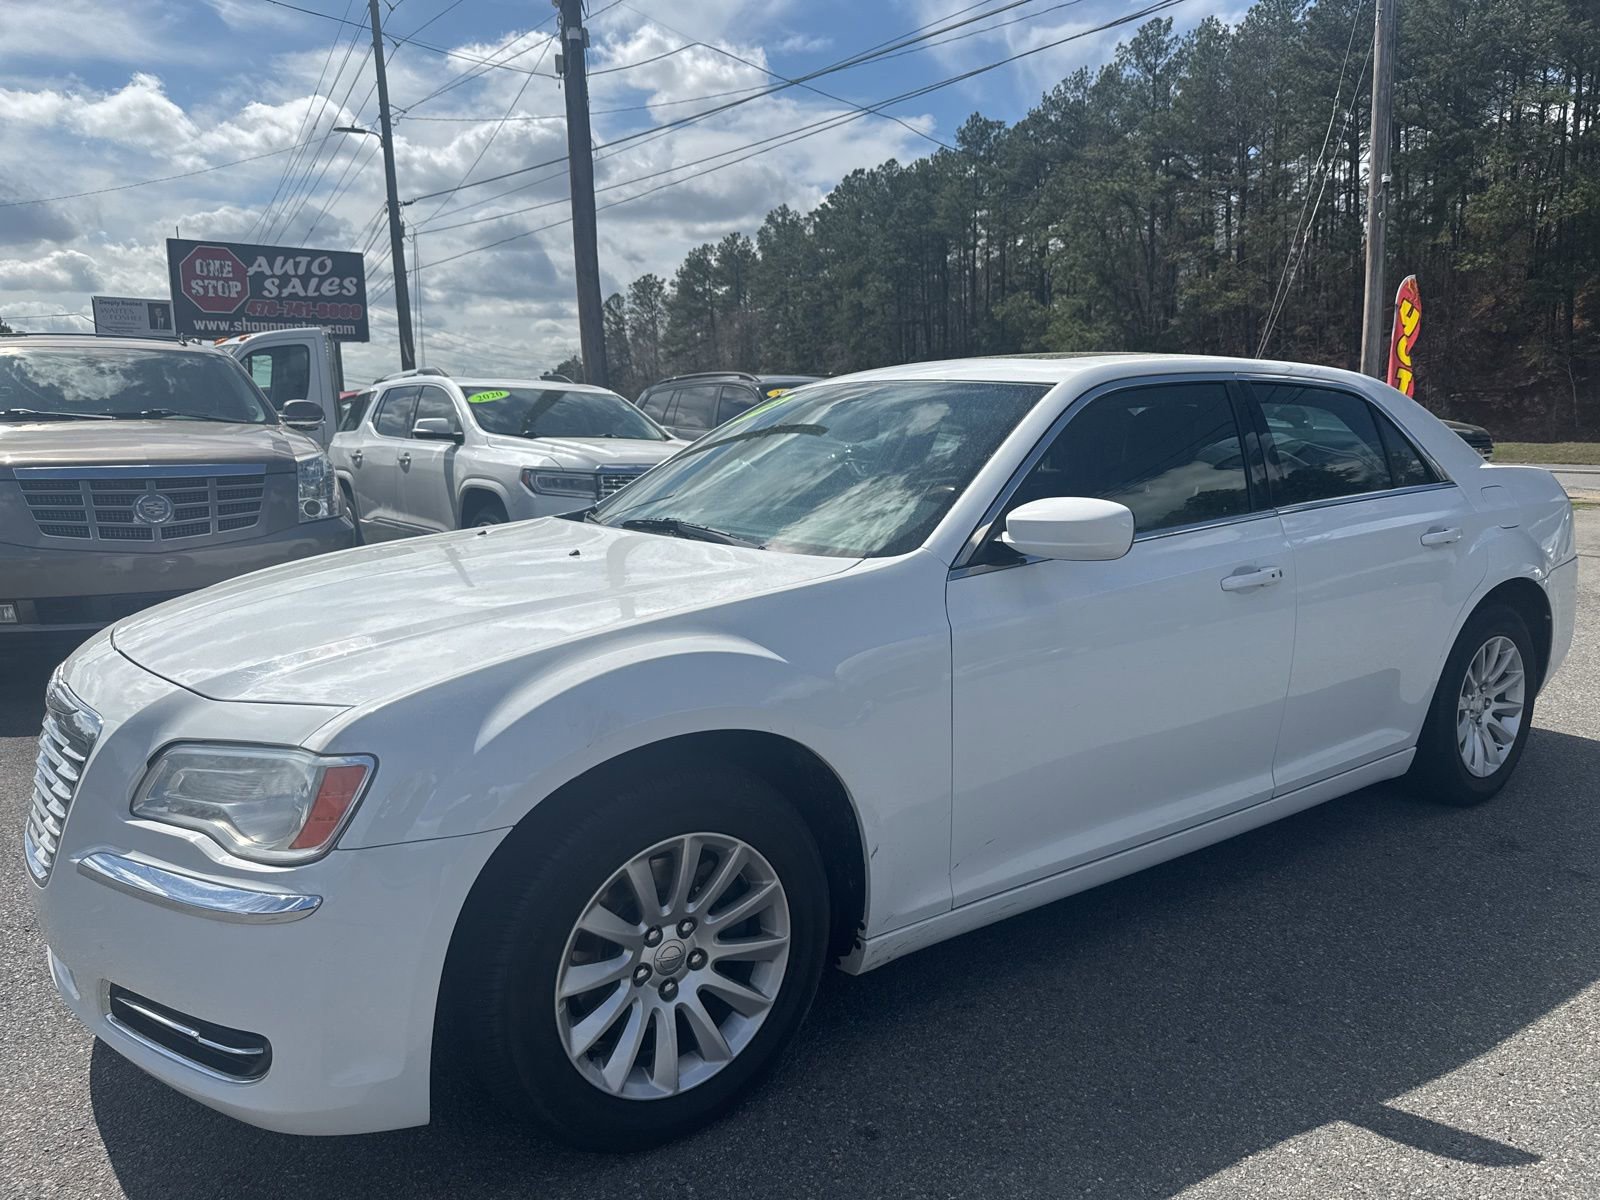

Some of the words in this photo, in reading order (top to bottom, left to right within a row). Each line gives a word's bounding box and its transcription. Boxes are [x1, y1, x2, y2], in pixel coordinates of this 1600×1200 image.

[195, 258, 233, 278] ONE
[246, 255, 333, 276] AUTO
[190, 279, 242, 298] STOP
[262, 276, 358, 298] SALES
[193, 317, 356, 335] www.shoponecom
[477, 391, 503, 402] 2020
